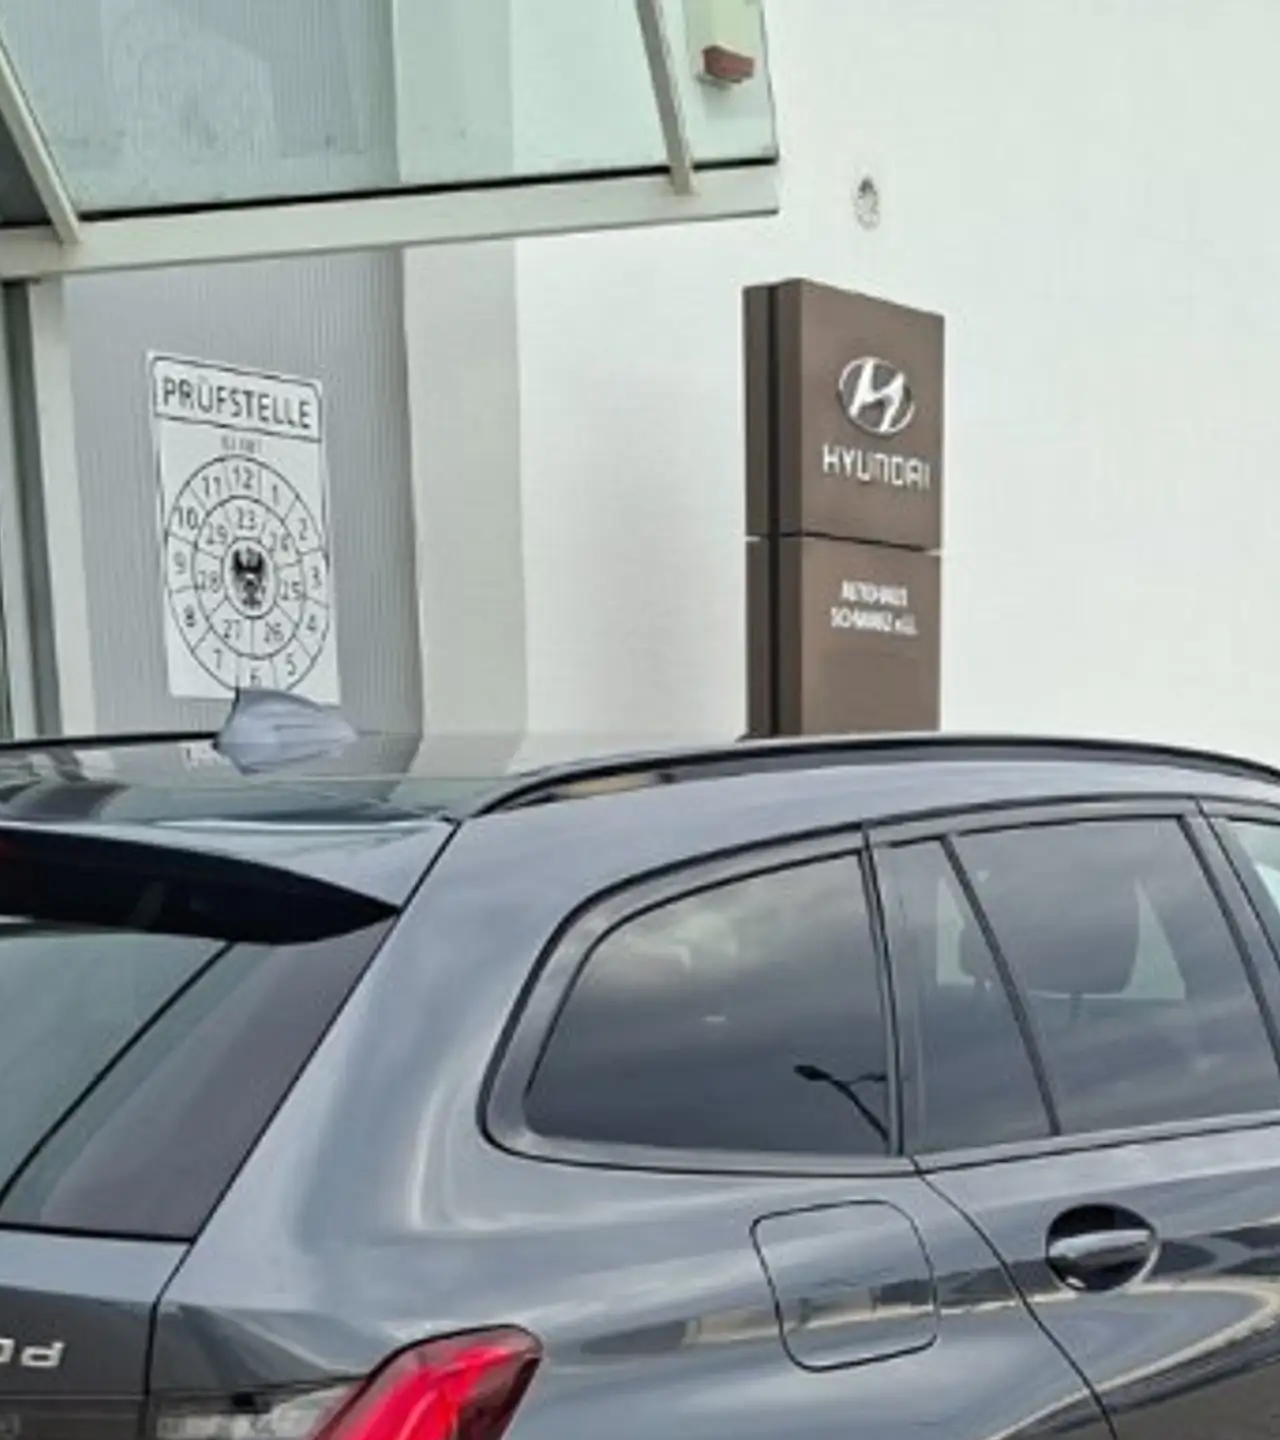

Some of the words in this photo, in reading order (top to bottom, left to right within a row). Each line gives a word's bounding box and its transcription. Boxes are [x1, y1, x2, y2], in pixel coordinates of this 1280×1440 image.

[162, 374, 313, 430] PRÜFSTELLE
[233, 465, 255, 490] 12
[823, 444, 930, 489] HYUNDAI
[173, 506, 198, 530] 10
